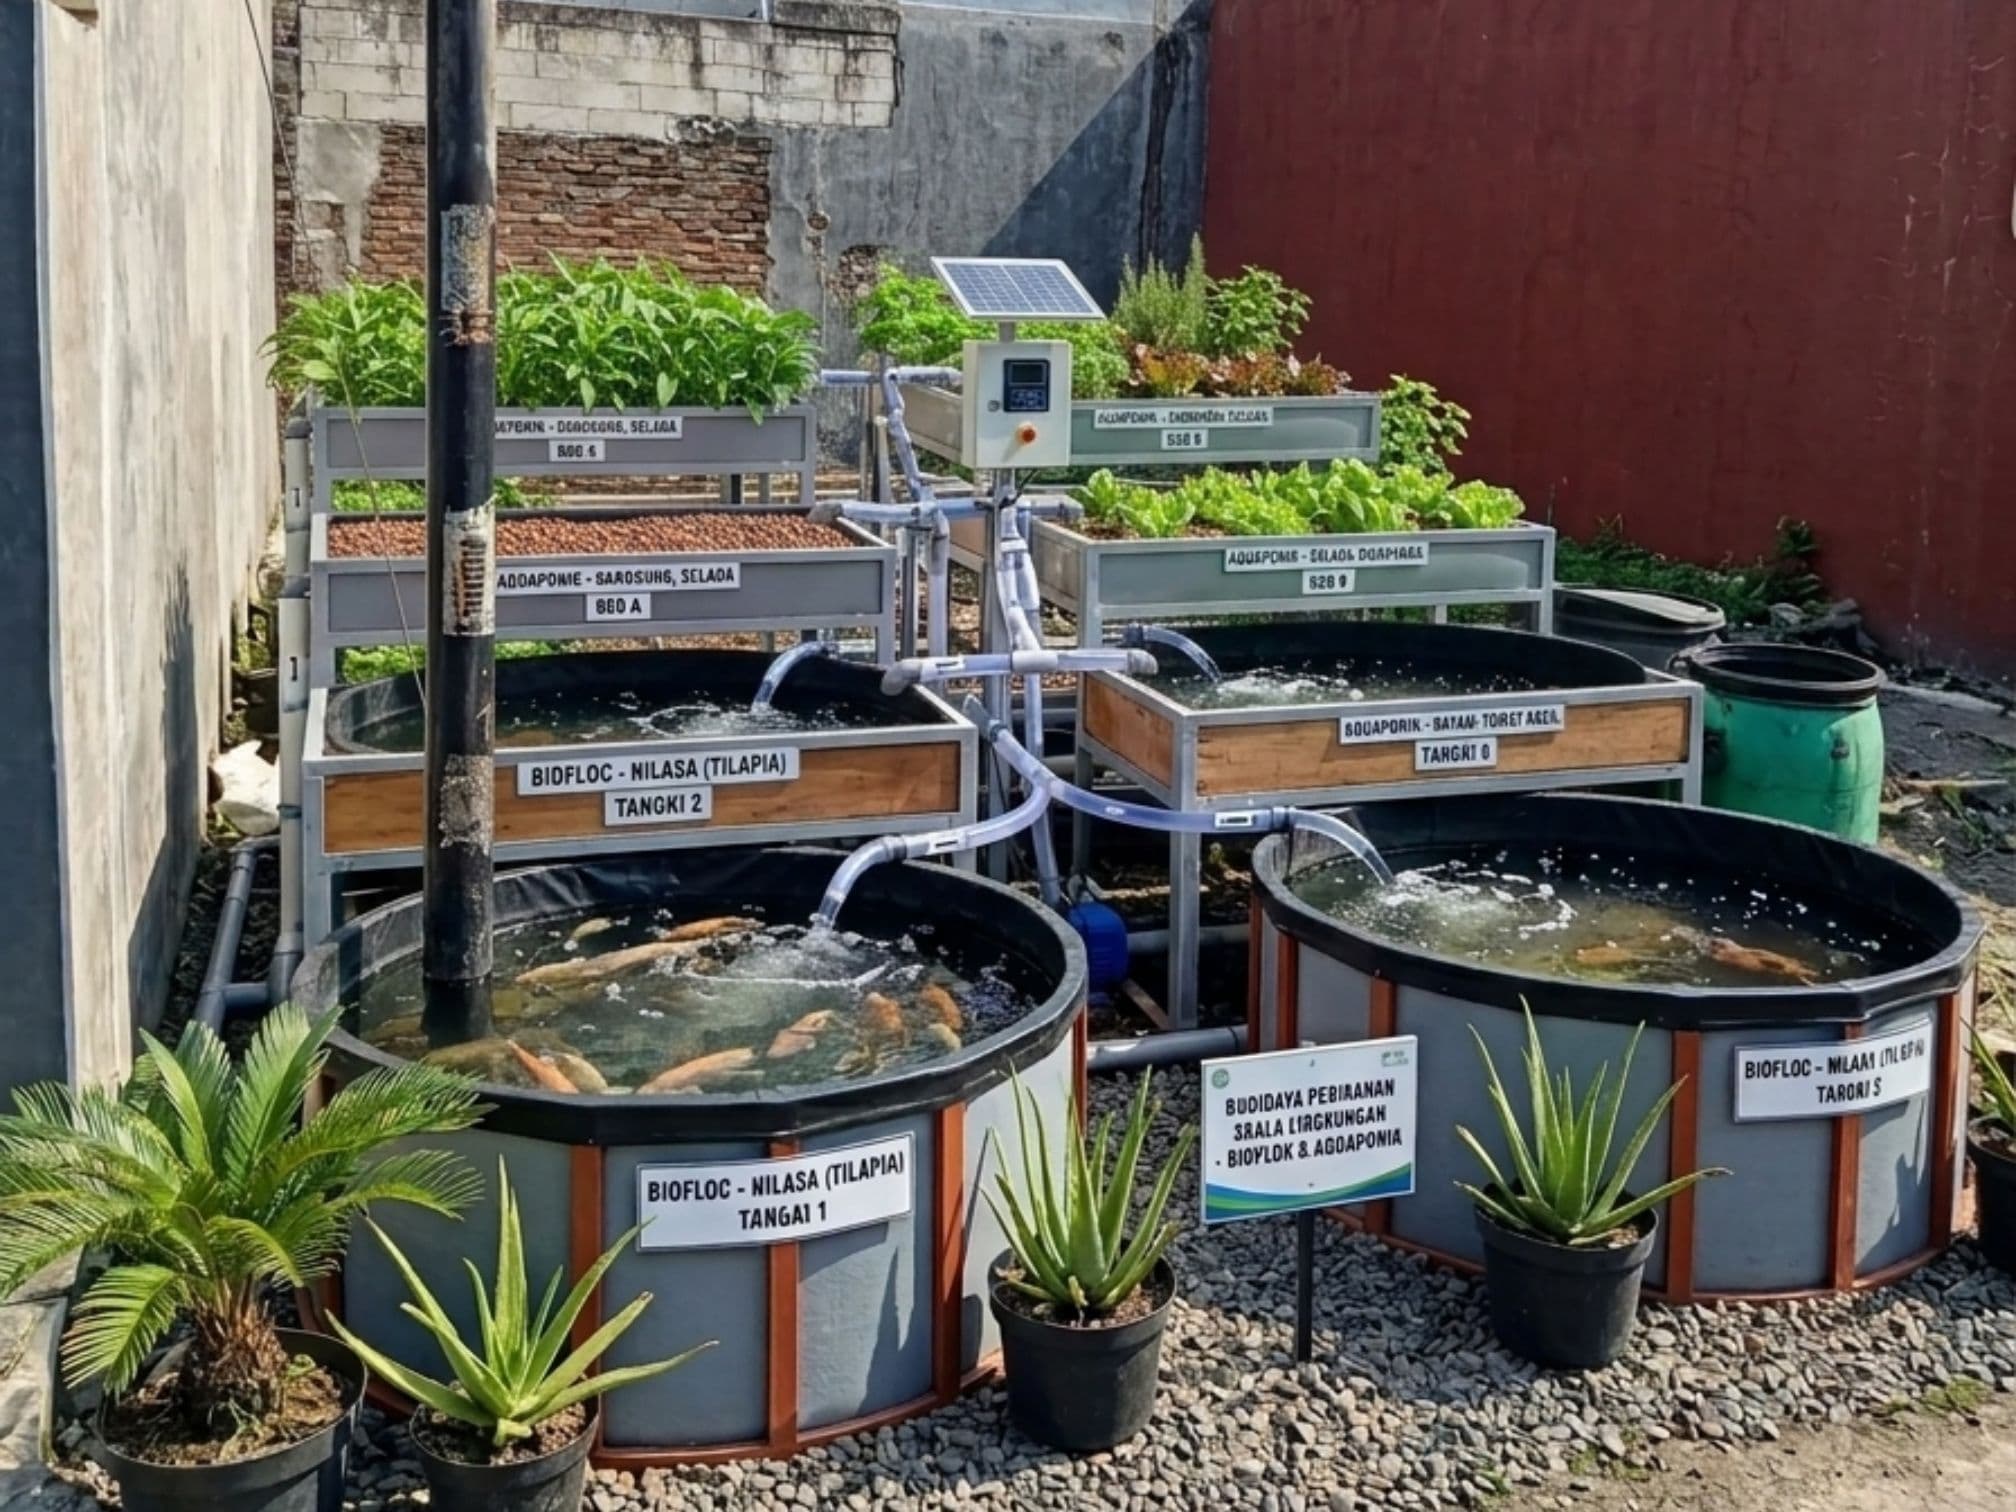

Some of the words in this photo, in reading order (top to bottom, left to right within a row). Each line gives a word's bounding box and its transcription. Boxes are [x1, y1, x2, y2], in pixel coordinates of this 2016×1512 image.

[630, 597, 642, 613] A
[531, 763, 613, 787] BIOFLOC
[631, 758, 699, 781] NILASA
[703, 752, 786, 781] (TILAPIA)
[614, 795, 685, 817] TANGKI
[691, 793, 703, 813] 2
[1744, 1057, 1812, 1080] BIOFLOC
[1225, 1090, 1304, 1117] BUDIDAYA
[648, 1177, 732, 1202] BIOFLOC
[751, 1168, 820, 1198] NILASA
[825, 1151, 904, 1191] (TILAPIA)
[818, 1200, 827, 1222] 1
